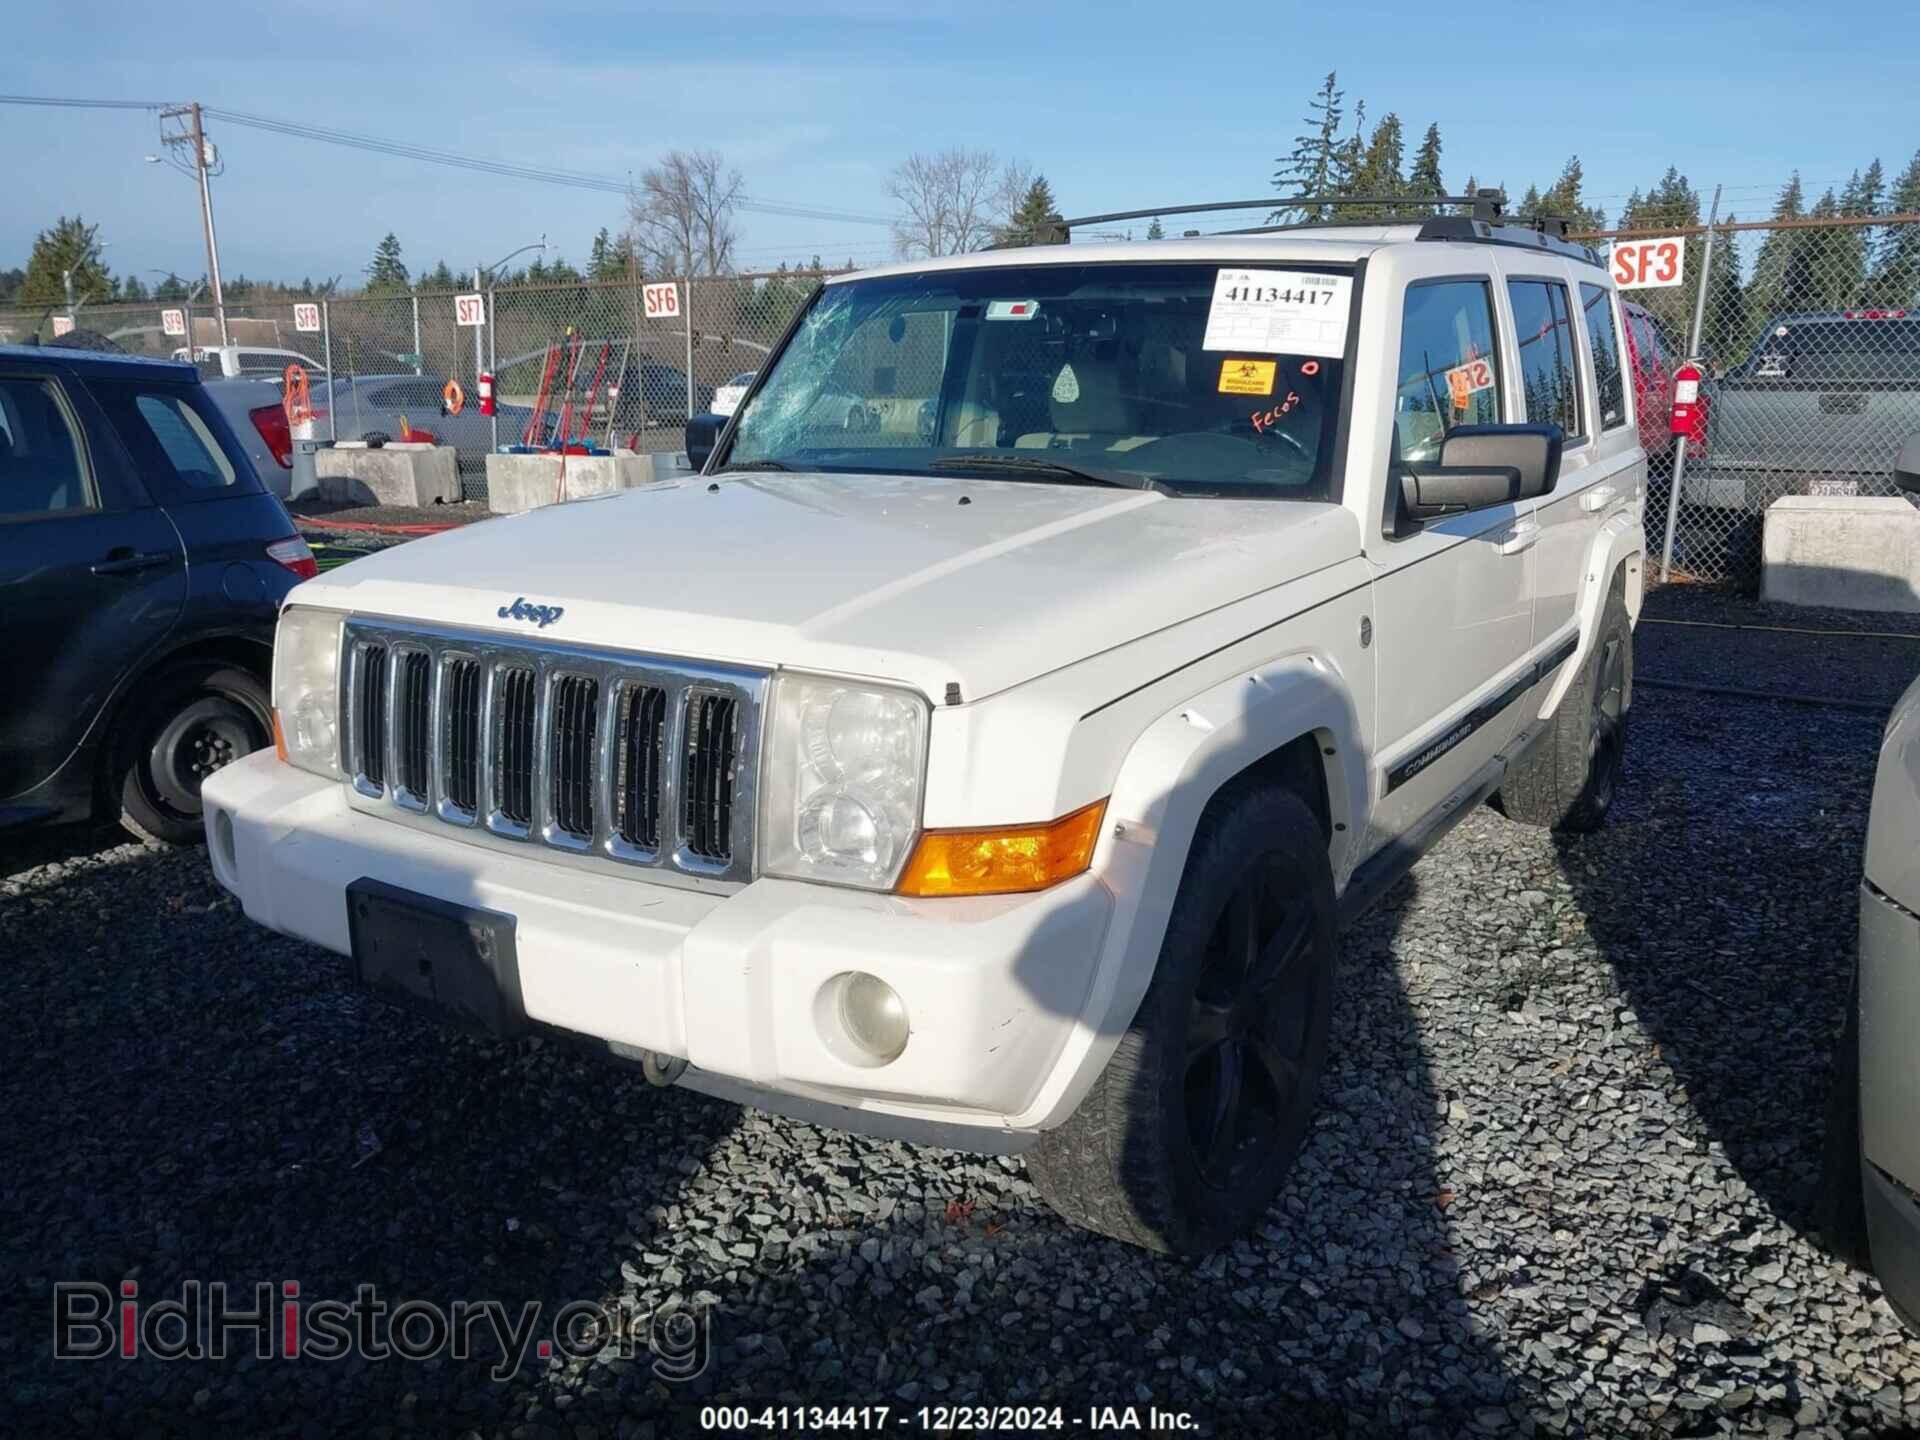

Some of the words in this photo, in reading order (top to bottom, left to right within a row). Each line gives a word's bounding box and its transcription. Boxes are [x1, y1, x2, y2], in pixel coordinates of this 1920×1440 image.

[1615, 243, 1678, 284] SF3
[646, 287, 676, 313] SF6
[1225, 286, 1334, 306] 41134417
[297, 307, 317, 328] SF8
[458, 299, 480, 322] SF7
[164, 311, 183, 334] SF9
[497, 597, 564, 629] Jeep
